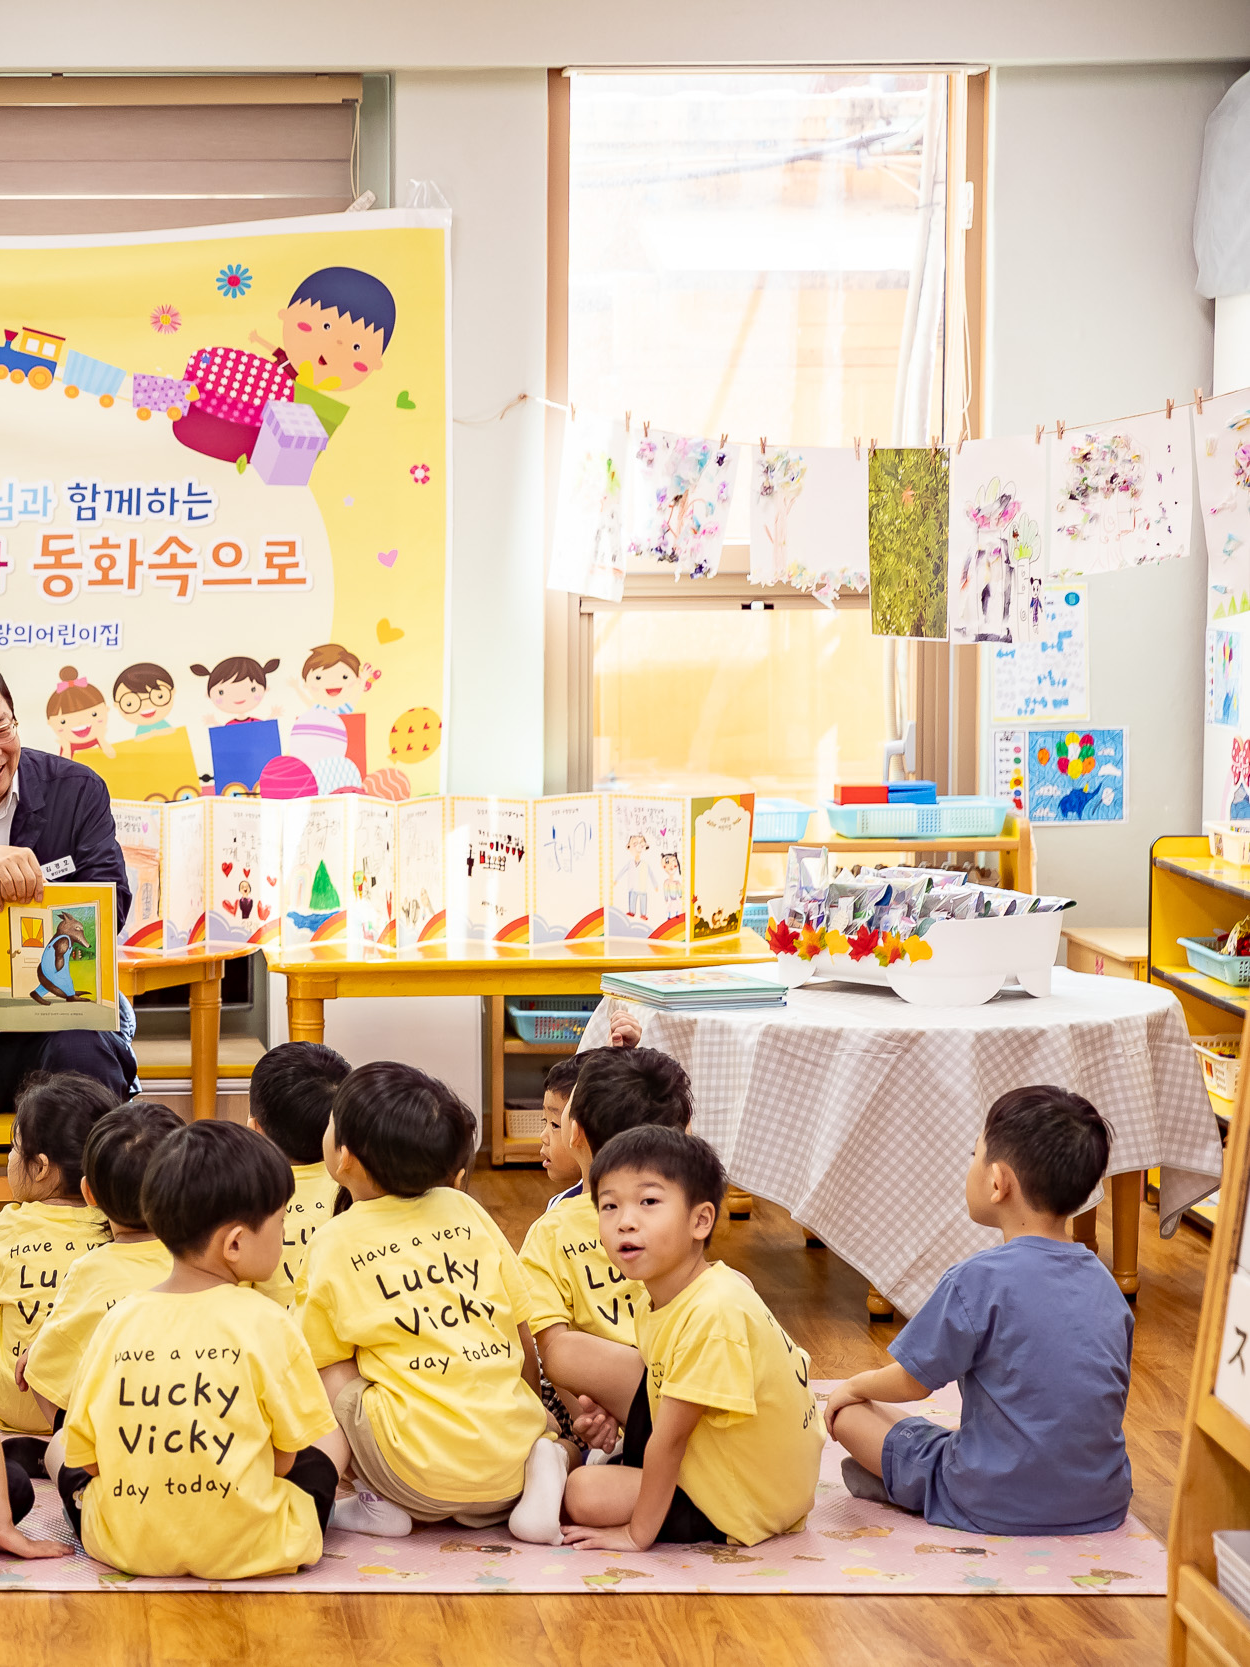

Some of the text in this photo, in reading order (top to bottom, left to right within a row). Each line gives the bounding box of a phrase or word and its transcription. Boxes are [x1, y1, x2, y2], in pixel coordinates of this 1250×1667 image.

[67, 481, 212, 521] 함께하는
[33, 533, 307, 598] 동화속으로
[316, 1201, 325, 1209] a
[10, 1241, 76, 1259] Have a
[351, 1226, 472, 1272] Have a very
[375, 1252, 479, 1300] Lucky
[170, 1349, 181, 1360] a
[195, 1348, 241, 1365] very
[409, 1341, 512, 1376] day today
[119, 1372, 240, 1419] Lucky
[118, 1419, 235, 1466] Vicky
[113, 1478, 150, 1505] day
